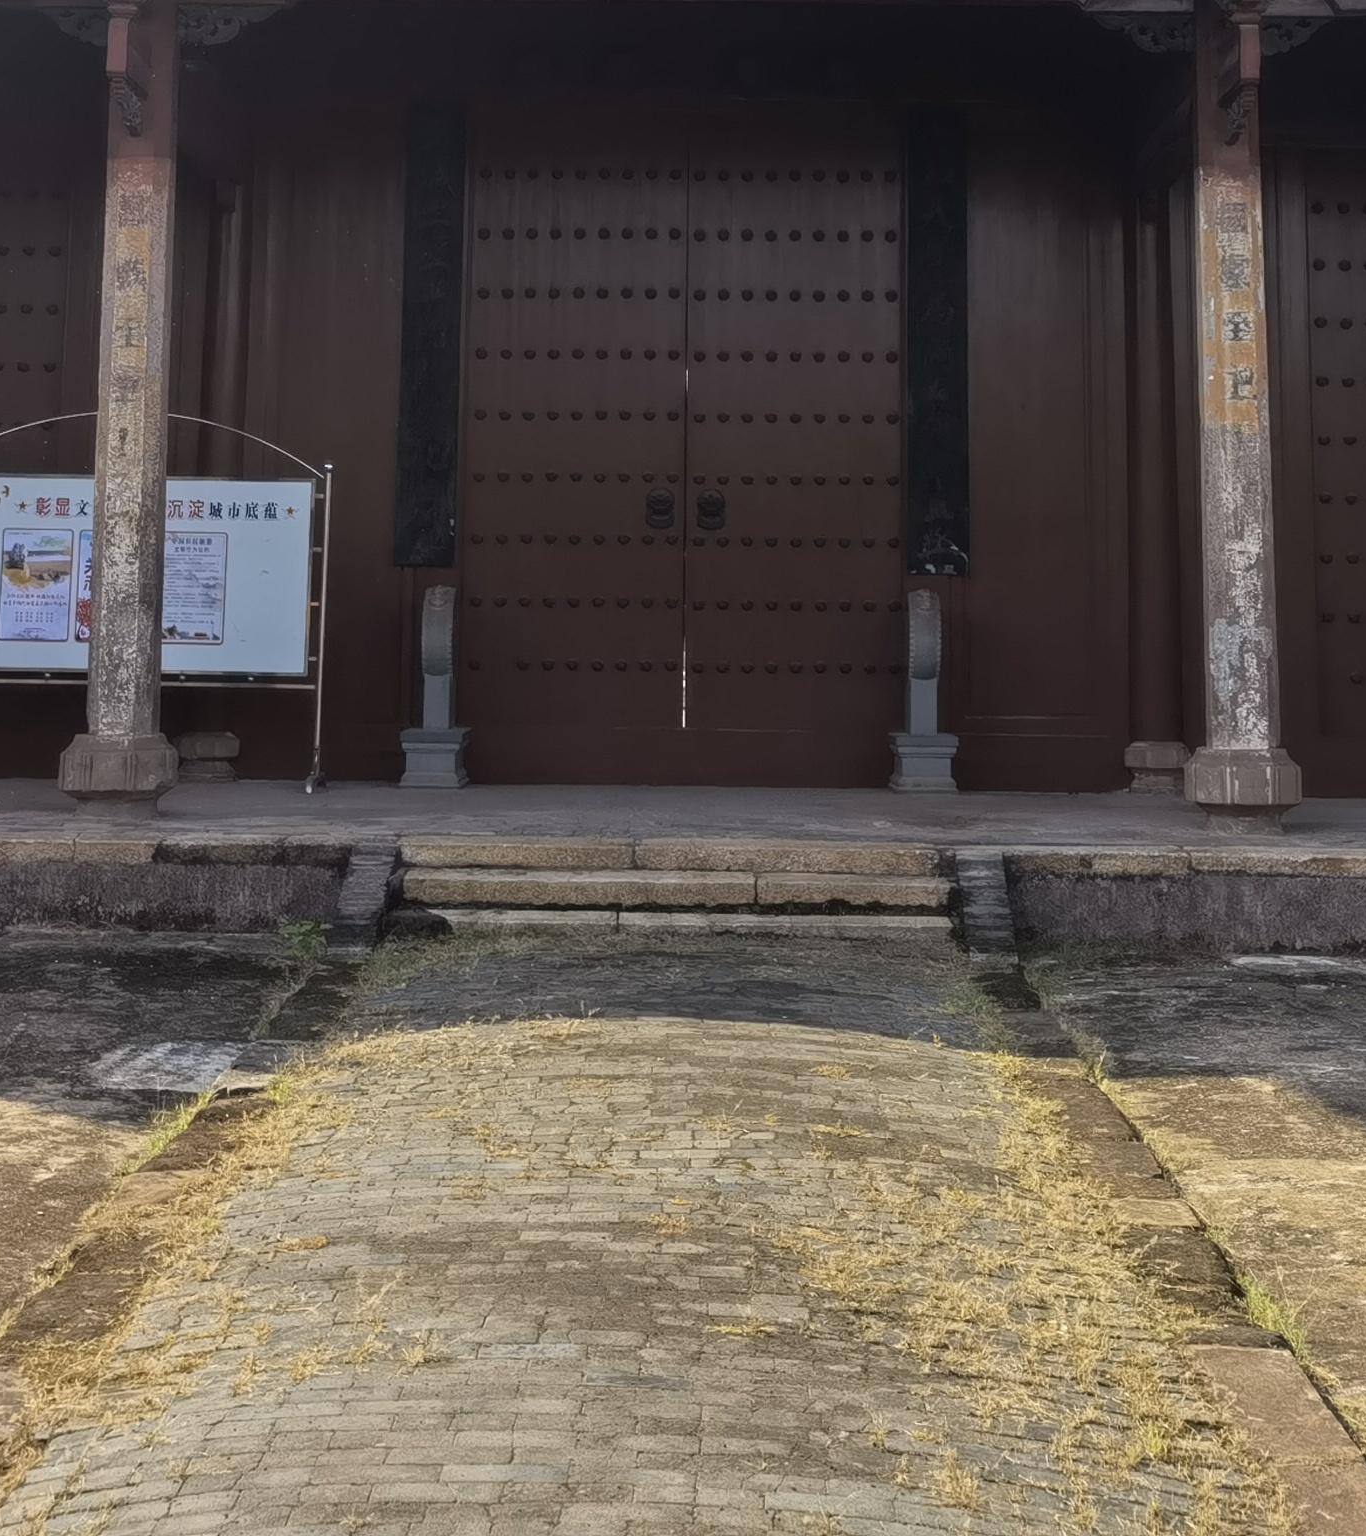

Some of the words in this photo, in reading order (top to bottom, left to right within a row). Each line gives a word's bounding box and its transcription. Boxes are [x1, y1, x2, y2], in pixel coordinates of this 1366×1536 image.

[36, 497, 91, 517] 彰显文
[167, 499, 279, 520] 沉淀城市底蕴
